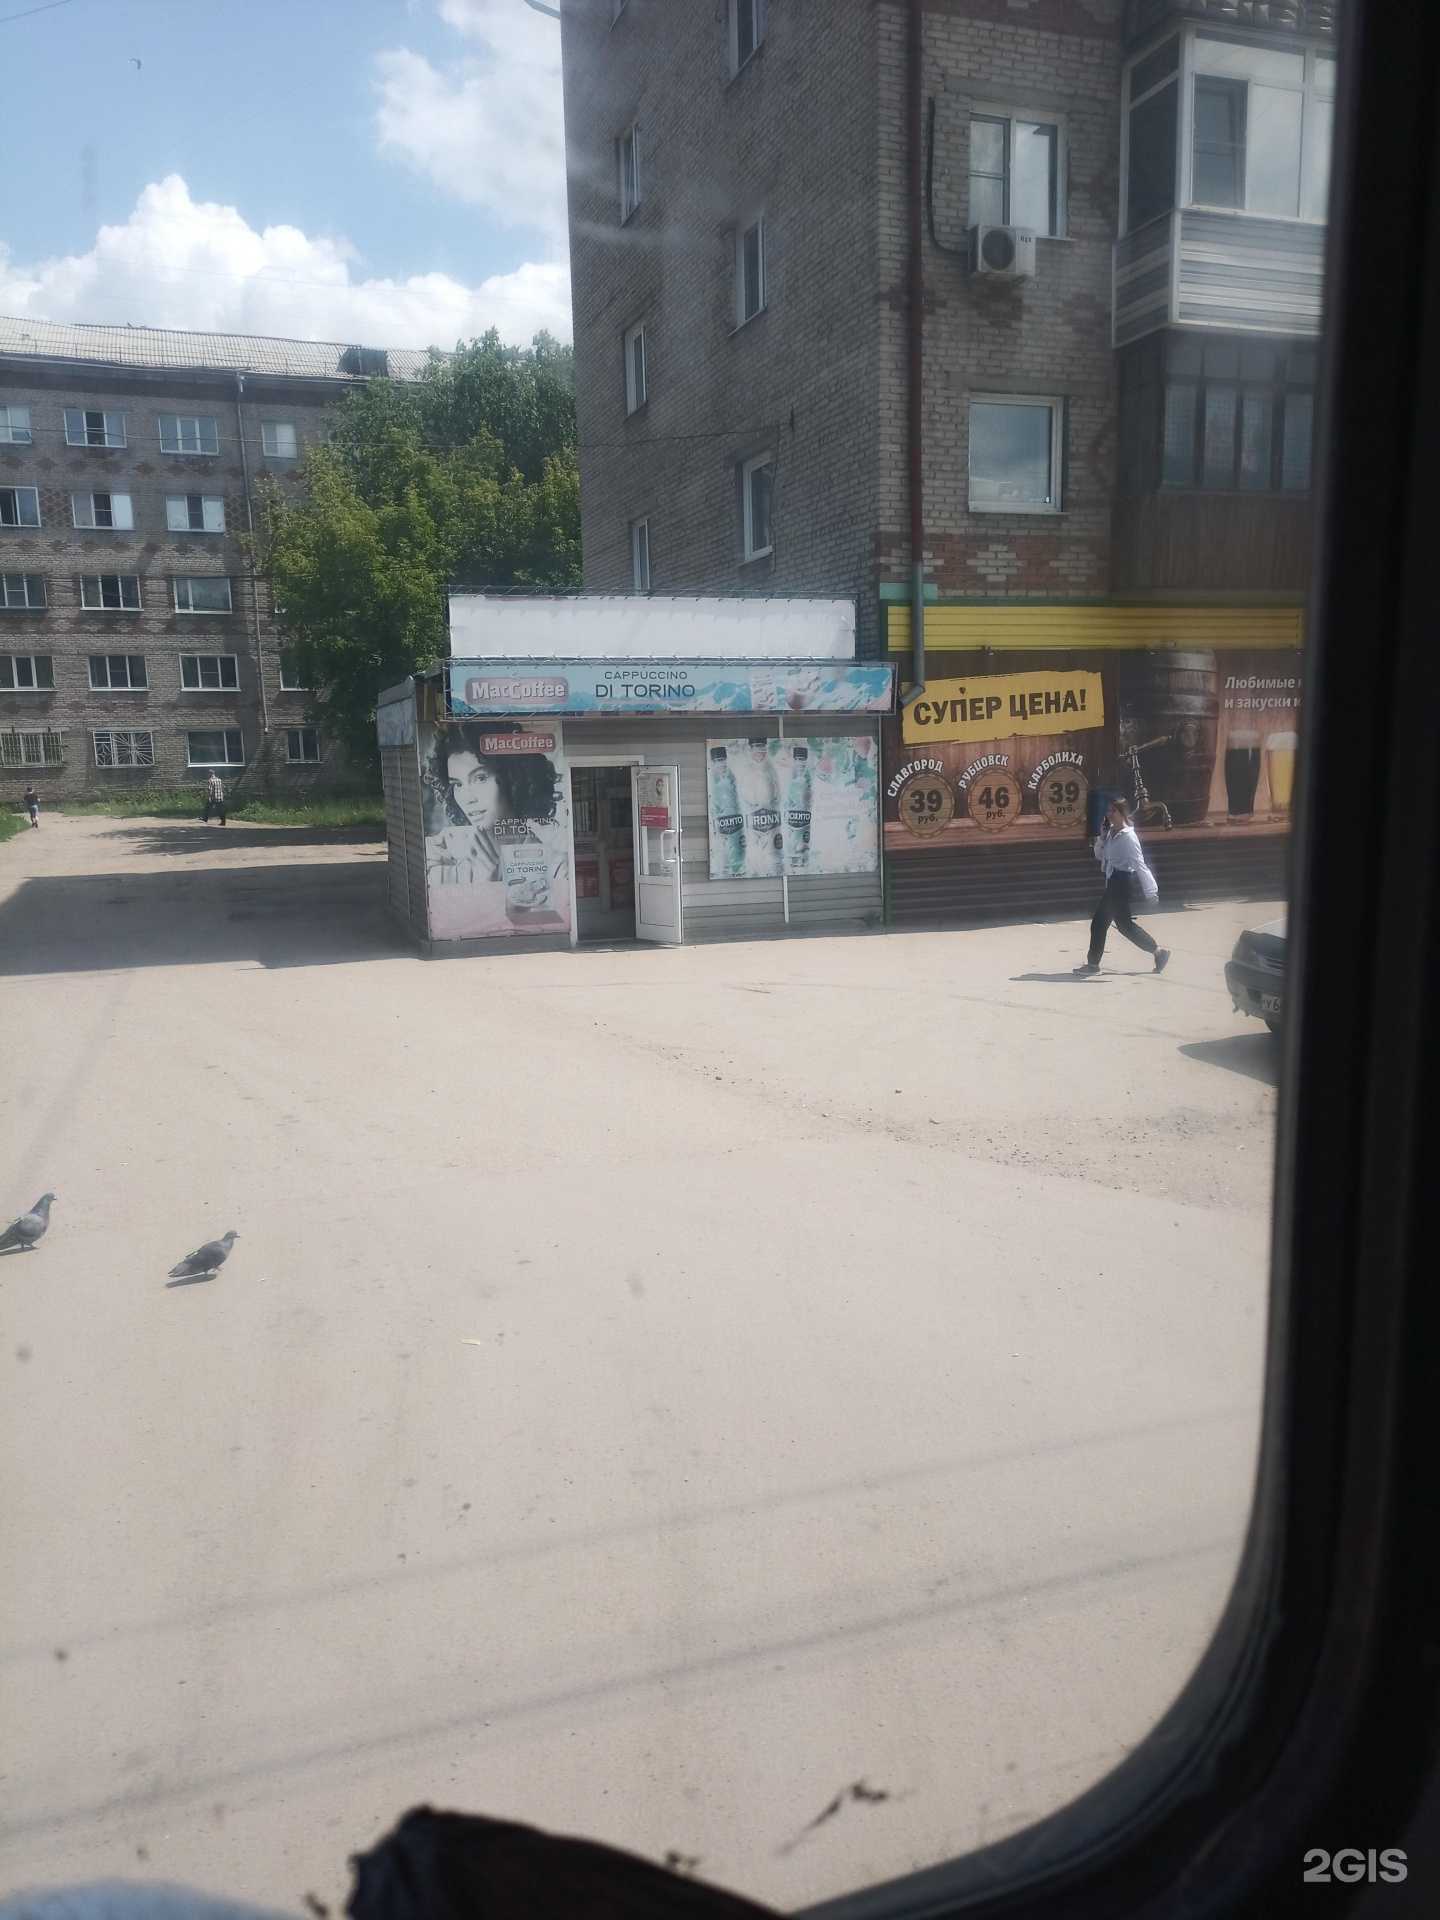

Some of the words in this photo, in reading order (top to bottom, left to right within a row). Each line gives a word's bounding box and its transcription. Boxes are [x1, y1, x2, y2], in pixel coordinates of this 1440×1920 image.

[604, 671, 688, 680] CAPPUCCINO
[1224, 676, 1296, 689] Любимые
[471, 680, 566, 700] MacCoffee
[595, 684, 617, 698] DI
[621, 683, 696, 698] TORINO
[913, 696, 1002, 725] СУПЕР
[1009, 688, 1086, 720] ЦЕНА!
[1224, 698, 1233, 709] и
[1237, 697, 1291, 711] закуски
[485, 737, 553, 751] MacCoffee
[887, 758, 944, 797] СЛАВГОРОД
[958, 754, 1009, 789] РУБЦОВСК
[1027, 751, 1084, 789] КАРБОЛИХА
[978, 786, 1010, 809] 46
[1049, 781, 1080, 804] 39
[909, 789, 943, 814] 39
[986, 809, 1005, 820] руб.
[1056, 804, 1076, 815] руб.
[917, 813, 938, 825] руб.
[495, 825, 506, 835] DI
